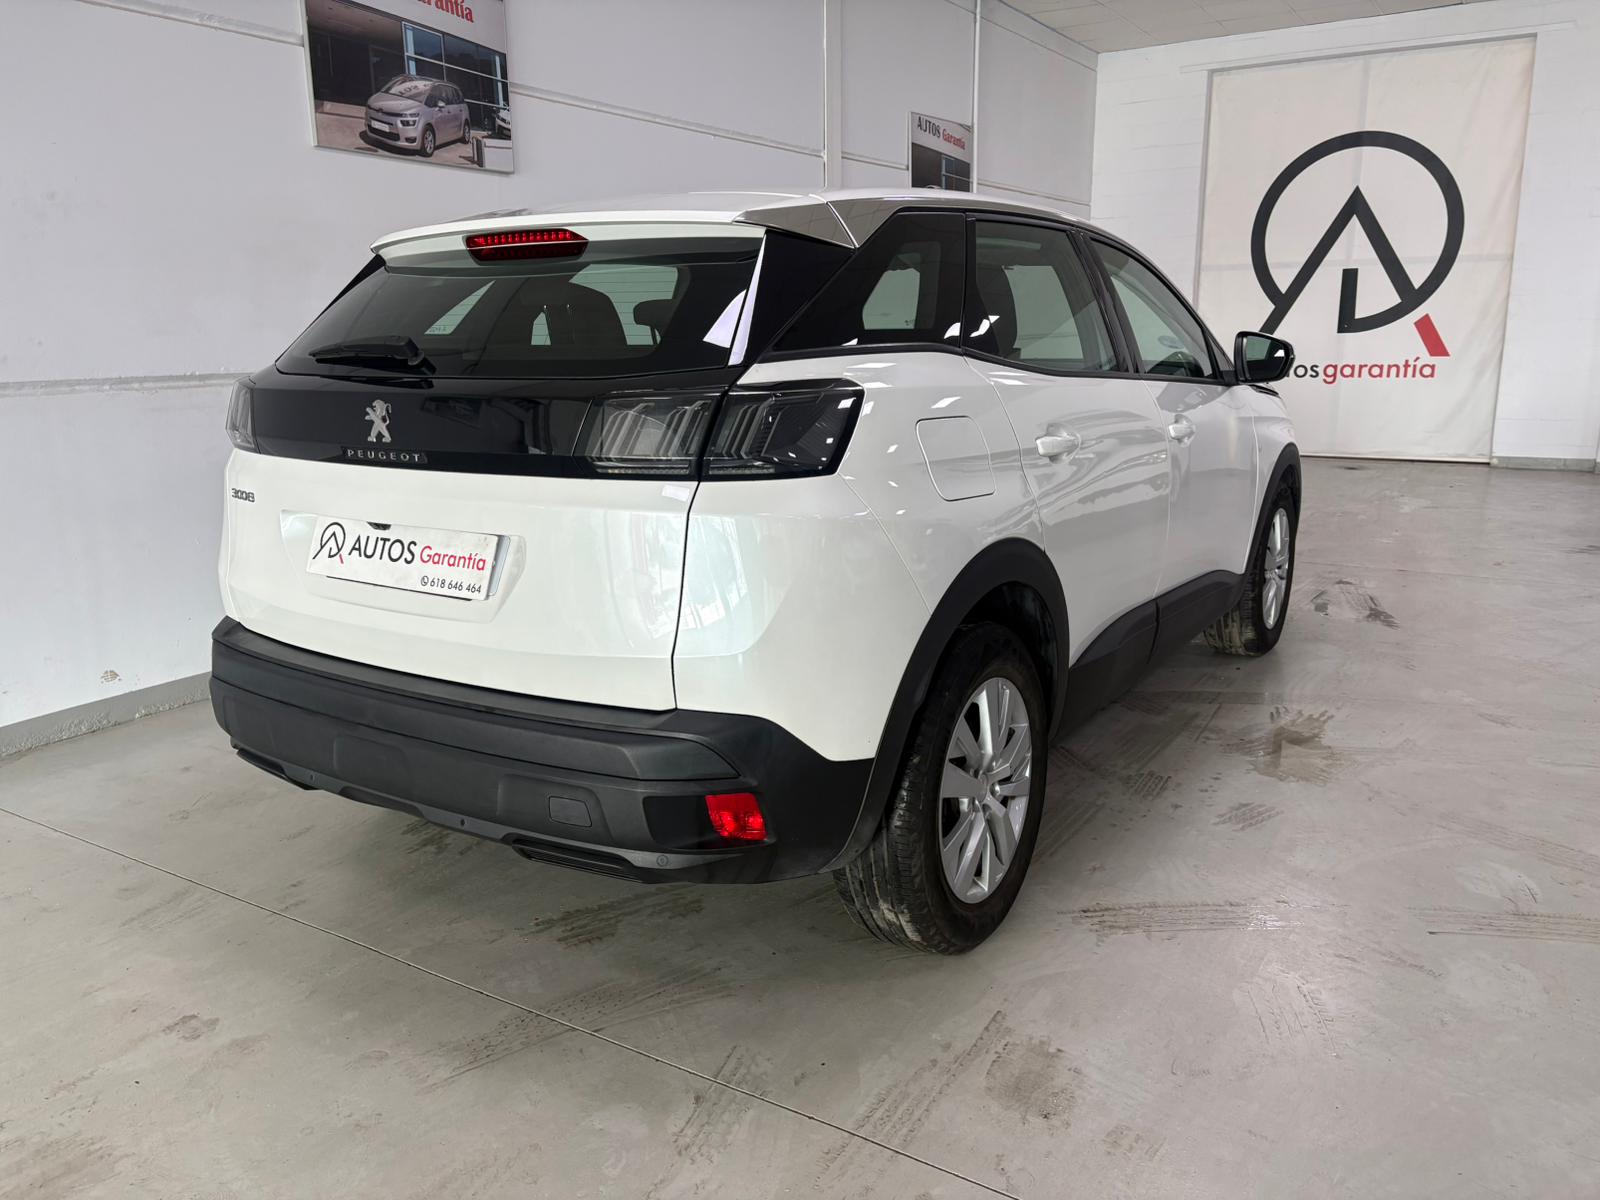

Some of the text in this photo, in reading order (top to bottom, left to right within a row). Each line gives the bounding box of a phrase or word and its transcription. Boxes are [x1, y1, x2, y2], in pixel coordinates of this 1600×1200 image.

[347, 449, 420, 462] PEUGEOT
[231, 487, 255, 503] 3008
[348, 534, 487, 571] AUTOS Garantía
[430, 577, 482, 594] 618 646 464
